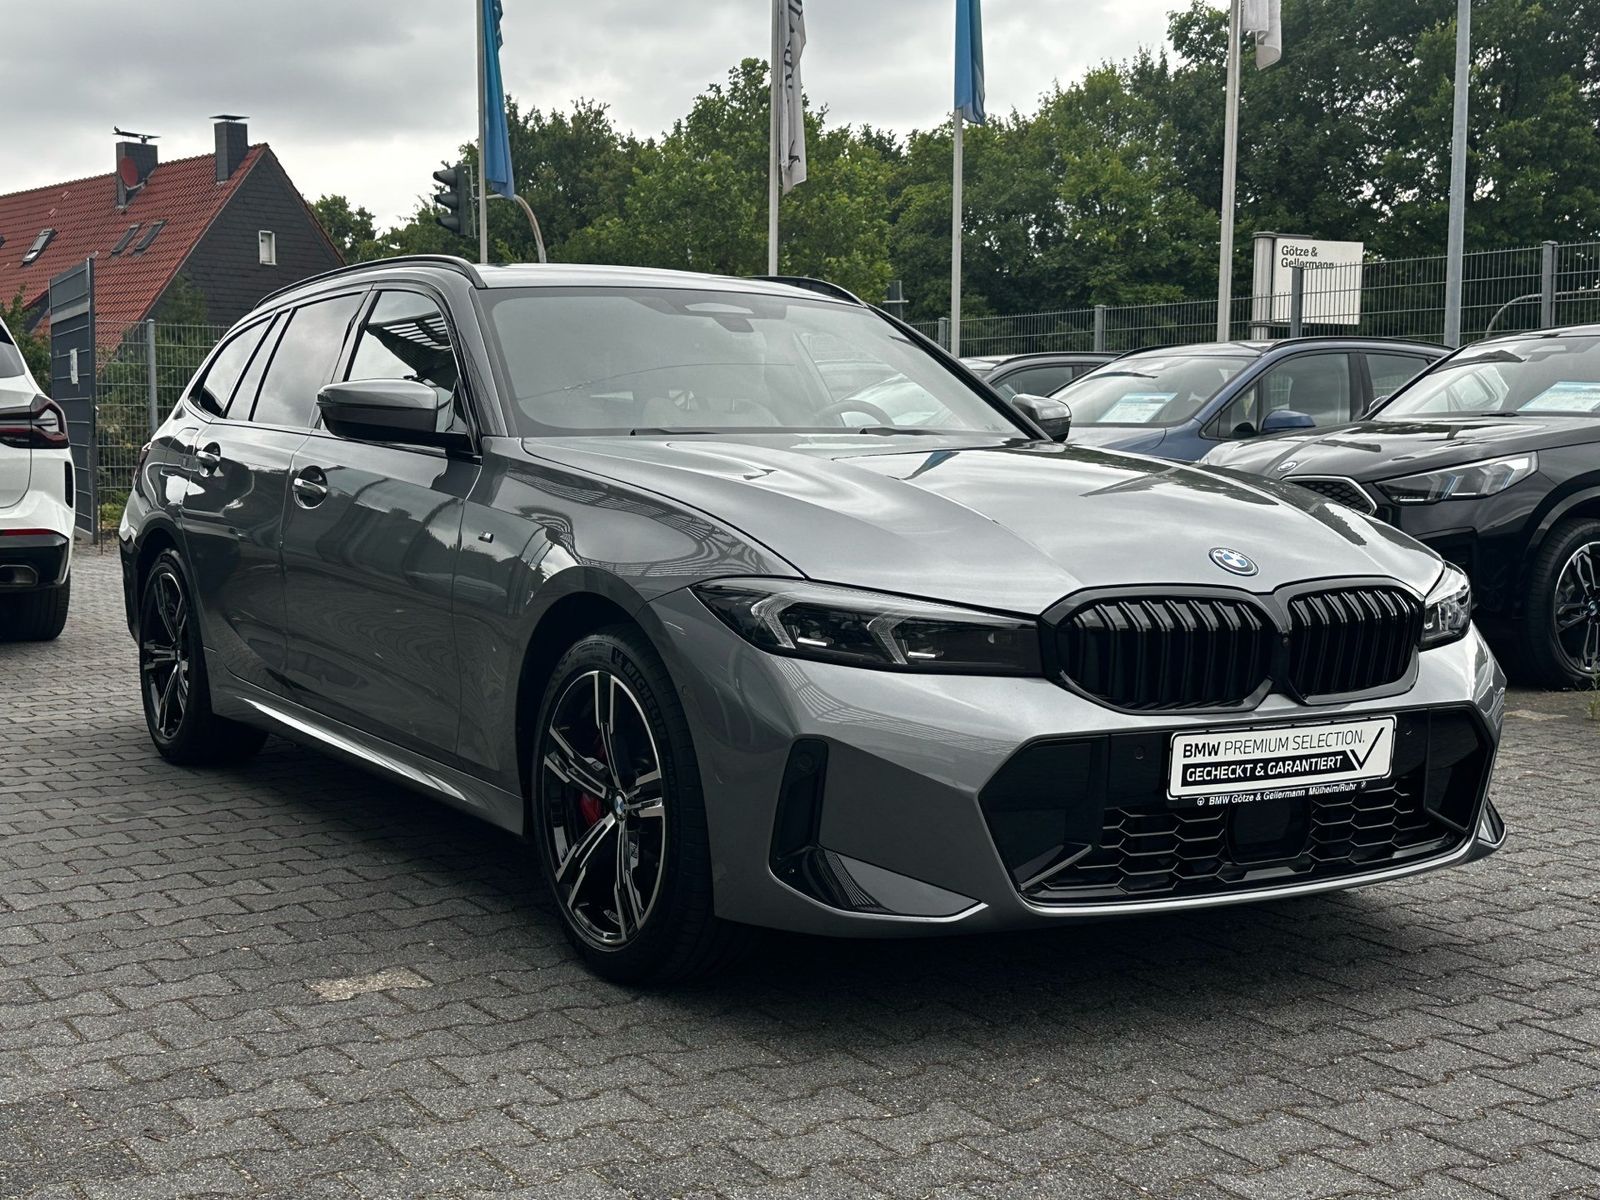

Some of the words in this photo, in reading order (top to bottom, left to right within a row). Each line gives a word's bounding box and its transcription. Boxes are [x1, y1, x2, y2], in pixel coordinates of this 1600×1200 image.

[1281, 245, 1309, 257] Götze
[1311, 247, 1318, 257] &
[624, 662, 667, 739] MICHELIN
[1183, 742, 1220, 758] BMW
[1224, 737, 1288, 755] PREMIUM
[1292, 730, 1365, 750] SELECTION.
[1186, 764, 1253, 781] GECHECKT
[1255, 763, 1265, 776] &
[1267, 756, 1343, 775] GARANTIERT
[1209, 796, 1229, 805] BMW
[1231, 793, 1254, 804] Götze
[1256, 793, 1262, 801] &
[1263, 789, 1305, 800] Gellermann
